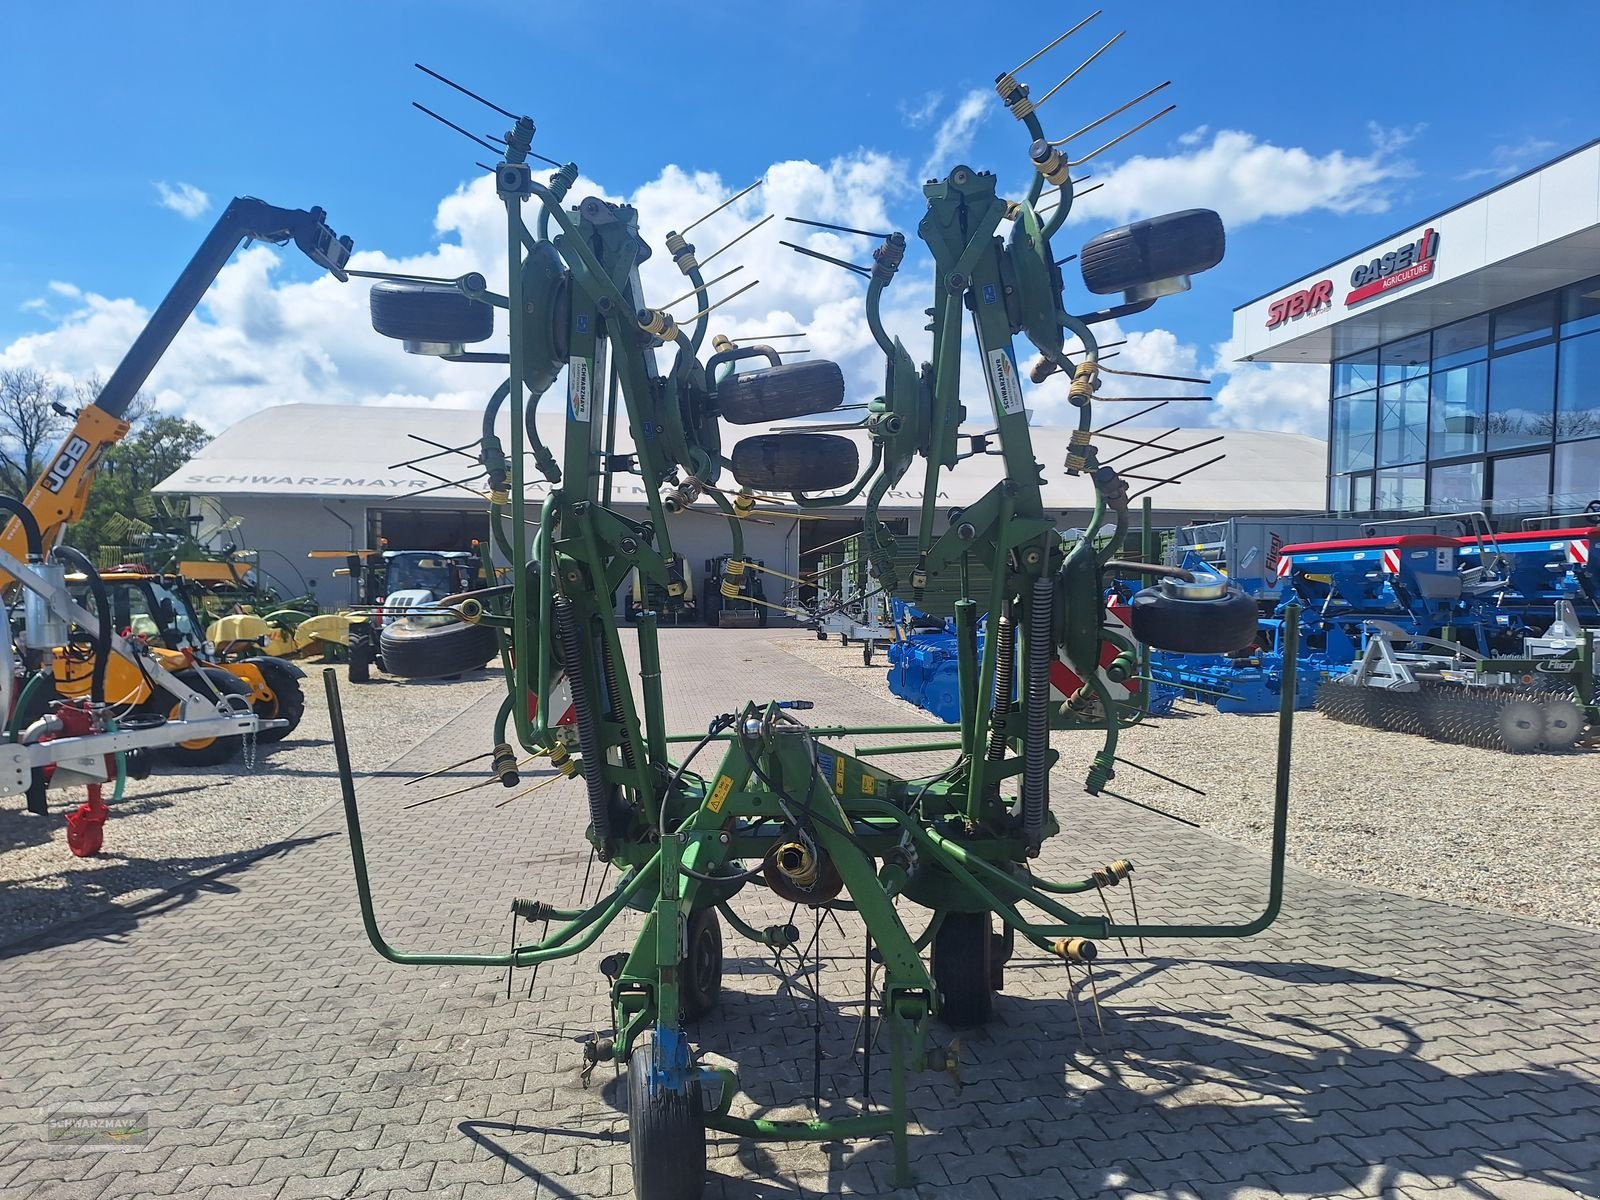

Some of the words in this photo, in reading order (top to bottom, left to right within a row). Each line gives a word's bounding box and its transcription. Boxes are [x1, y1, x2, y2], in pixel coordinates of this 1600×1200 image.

[1382, 263, 1428, 288] AGRICULTURE
[1265, 280, 1333, 327] STEYR
[995, 358, 1010, 409] SCHWARZMAYR
[42, 436, 89, 492] JCB
[184, 474, 427, 488] SCHWARZMAYR
[1265, 531, 1283, 571] Fliegl
[1547, 660, 1576, 672] Fliegl
